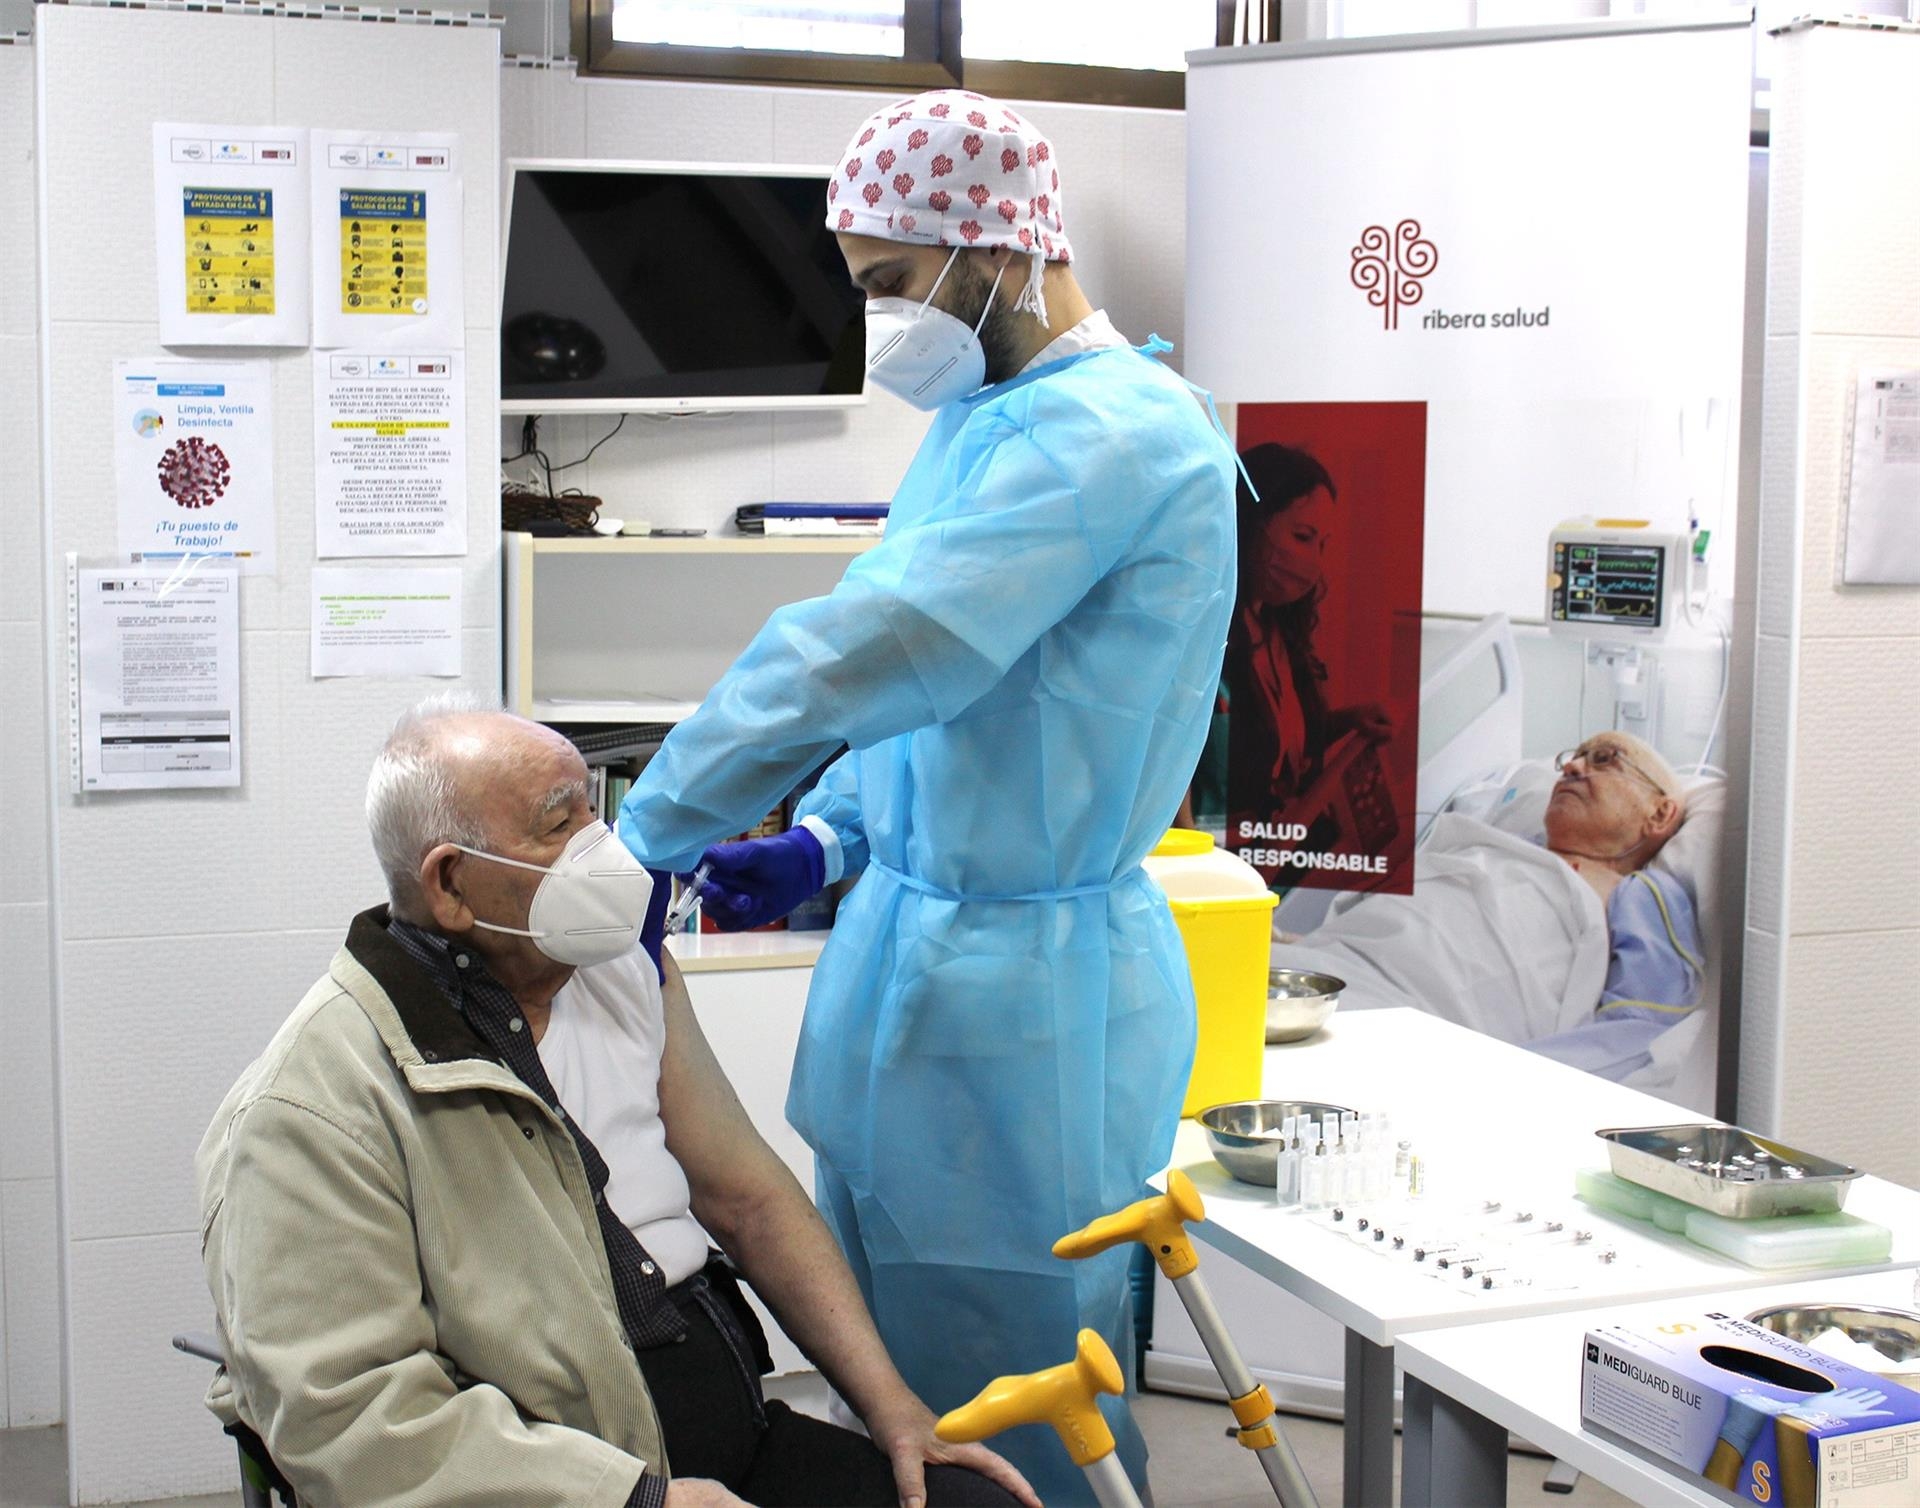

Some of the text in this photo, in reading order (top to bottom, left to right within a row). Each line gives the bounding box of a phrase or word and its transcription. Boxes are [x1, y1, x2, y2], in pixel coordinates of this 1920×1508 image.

[194, 193, 242, 202] PROTOCOLOS
[350, 195, 396, 203] PROTOCOLOS
[191, 201, 224, 209] ENTRADA
[1422, 306, 1550, 330] ribera salud
[177, 405, 254, 416] Limpia, Ventila
[178, 418, 233, 427] Desinfecta
[155, 520, 238, 534] ¡Tu puesto de
[174, 535, 223, 548] Trabajo!
[1239, 821, 1308, 841] SALUD
[1656, 1323, 1698, 1334] S
[1727, 1320, 1852, 1375] MEDIGUARD BLUE
[1603, 1352, 1702, 1410] MEDIGUARD BLUE
[1751, 1460, 1772, 1503] S
